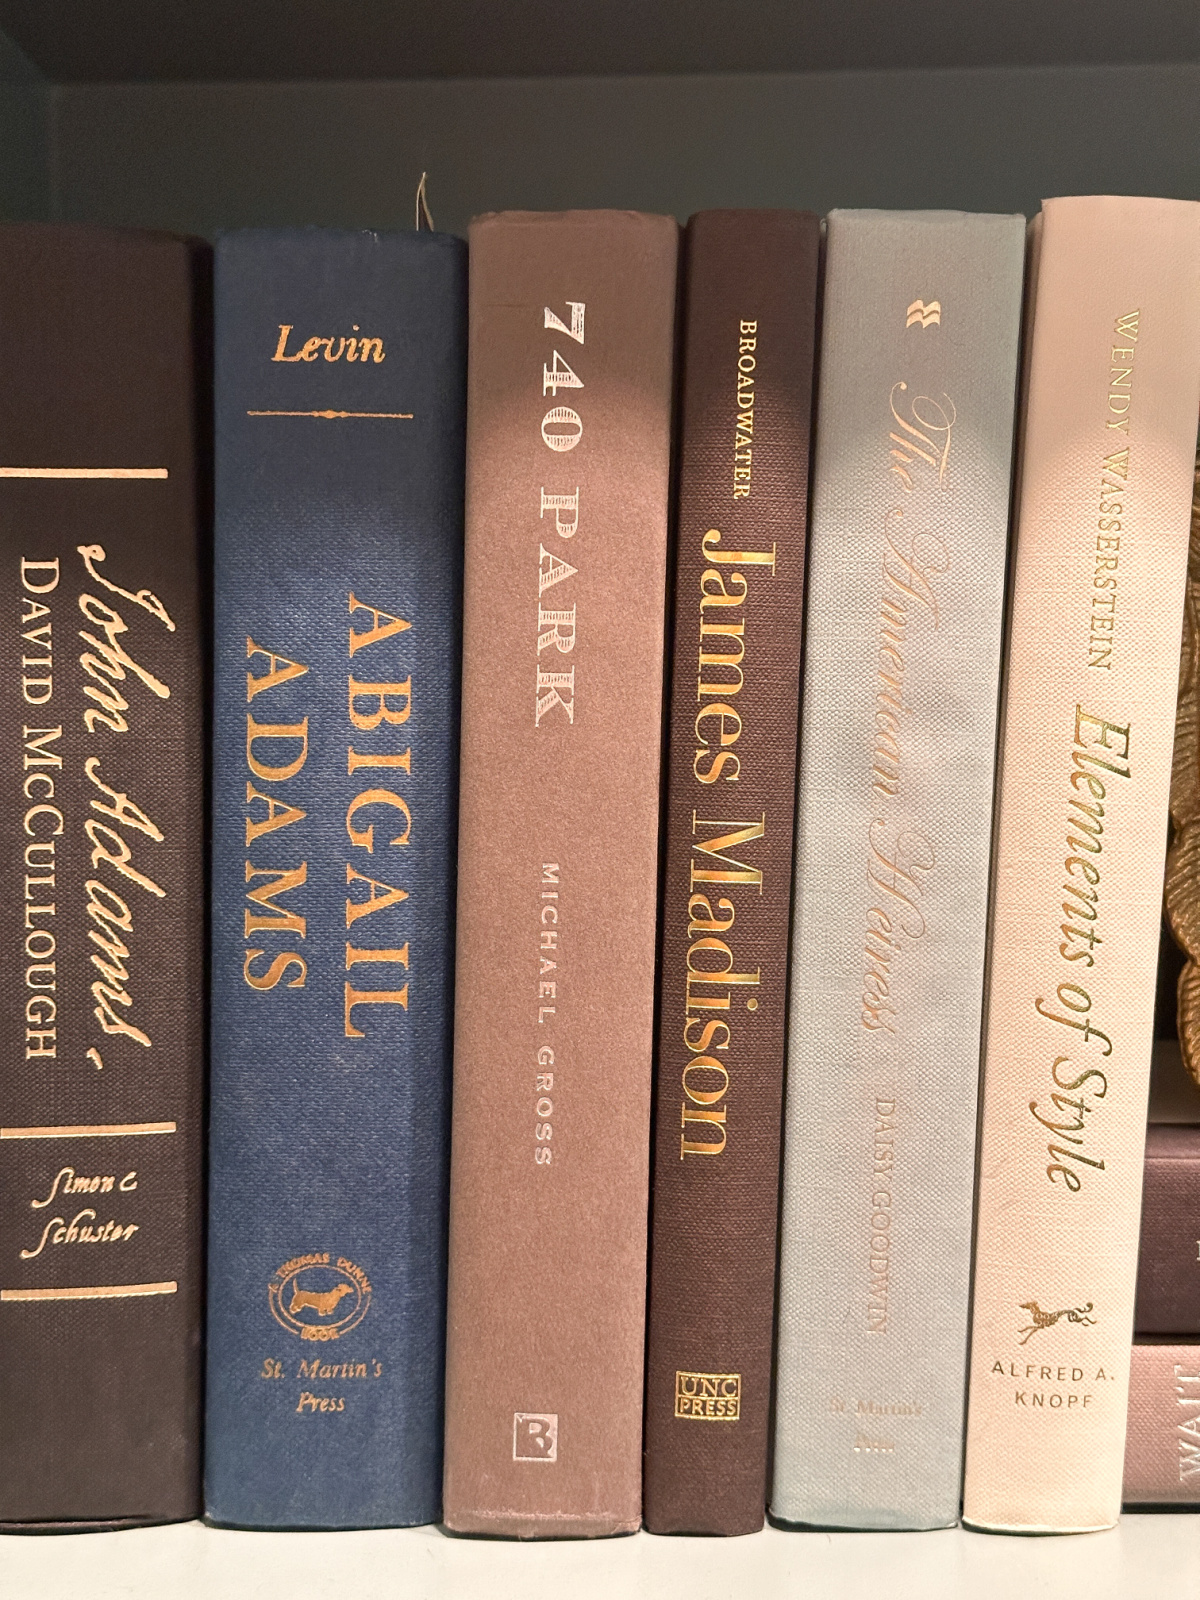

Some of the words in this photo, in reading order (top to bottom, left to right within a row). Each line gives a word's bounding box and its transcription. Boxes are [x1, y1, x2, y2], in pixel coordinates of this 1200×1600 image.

[271, 323, 386, 364] Levin
[540, 300, 586, 452] 740
[733, 319, 758, 501] BROADWATER
[1105, 308, 1141, 437] WENDY
[889, 381, 956, 493] The
[534, 486, 580, 728] PARK
[1087, 446, 1131, 671] WASSERSTEIN
[20, 556, 61, 707] DAVID
[77, 544, 176, 734] John
[692, 528, 776, 785] James
[872, 509, 949, 799] American
[243, 636, 309, 991] ADAMS
[344, 591, 413, 1039] ABIGAIL
[1058, 704, 1132, 969] Elements
[537, 862, 560, 1024] MICHAEL
[680, 809, 766, 1161] Madison
[861, 818, 936, 1035] Heiress
[1034, 982, 1113, 1057] of
[534, 1045, 556, 1166] GROSS
[873, 1097, 896, 1183] DAISY
[1029, 1056, 1108, 1194] Style
[19, 1208, 140, 1260] Schuster
[866, 1191, 893, 1335] GOODWIN
[295, 1390, 346, 1413] Press
[296, 1357, 383, 1380] Martin's
[679, 1375, 738, 1398] UNC
[679, 1398, 737, 1416] PRESS
[991, 1360, 1084, 1382] ALFRED
[1095, 1367, 1115, 1381] A.
[1014, 1391, 1093, 1409] KNOPF
